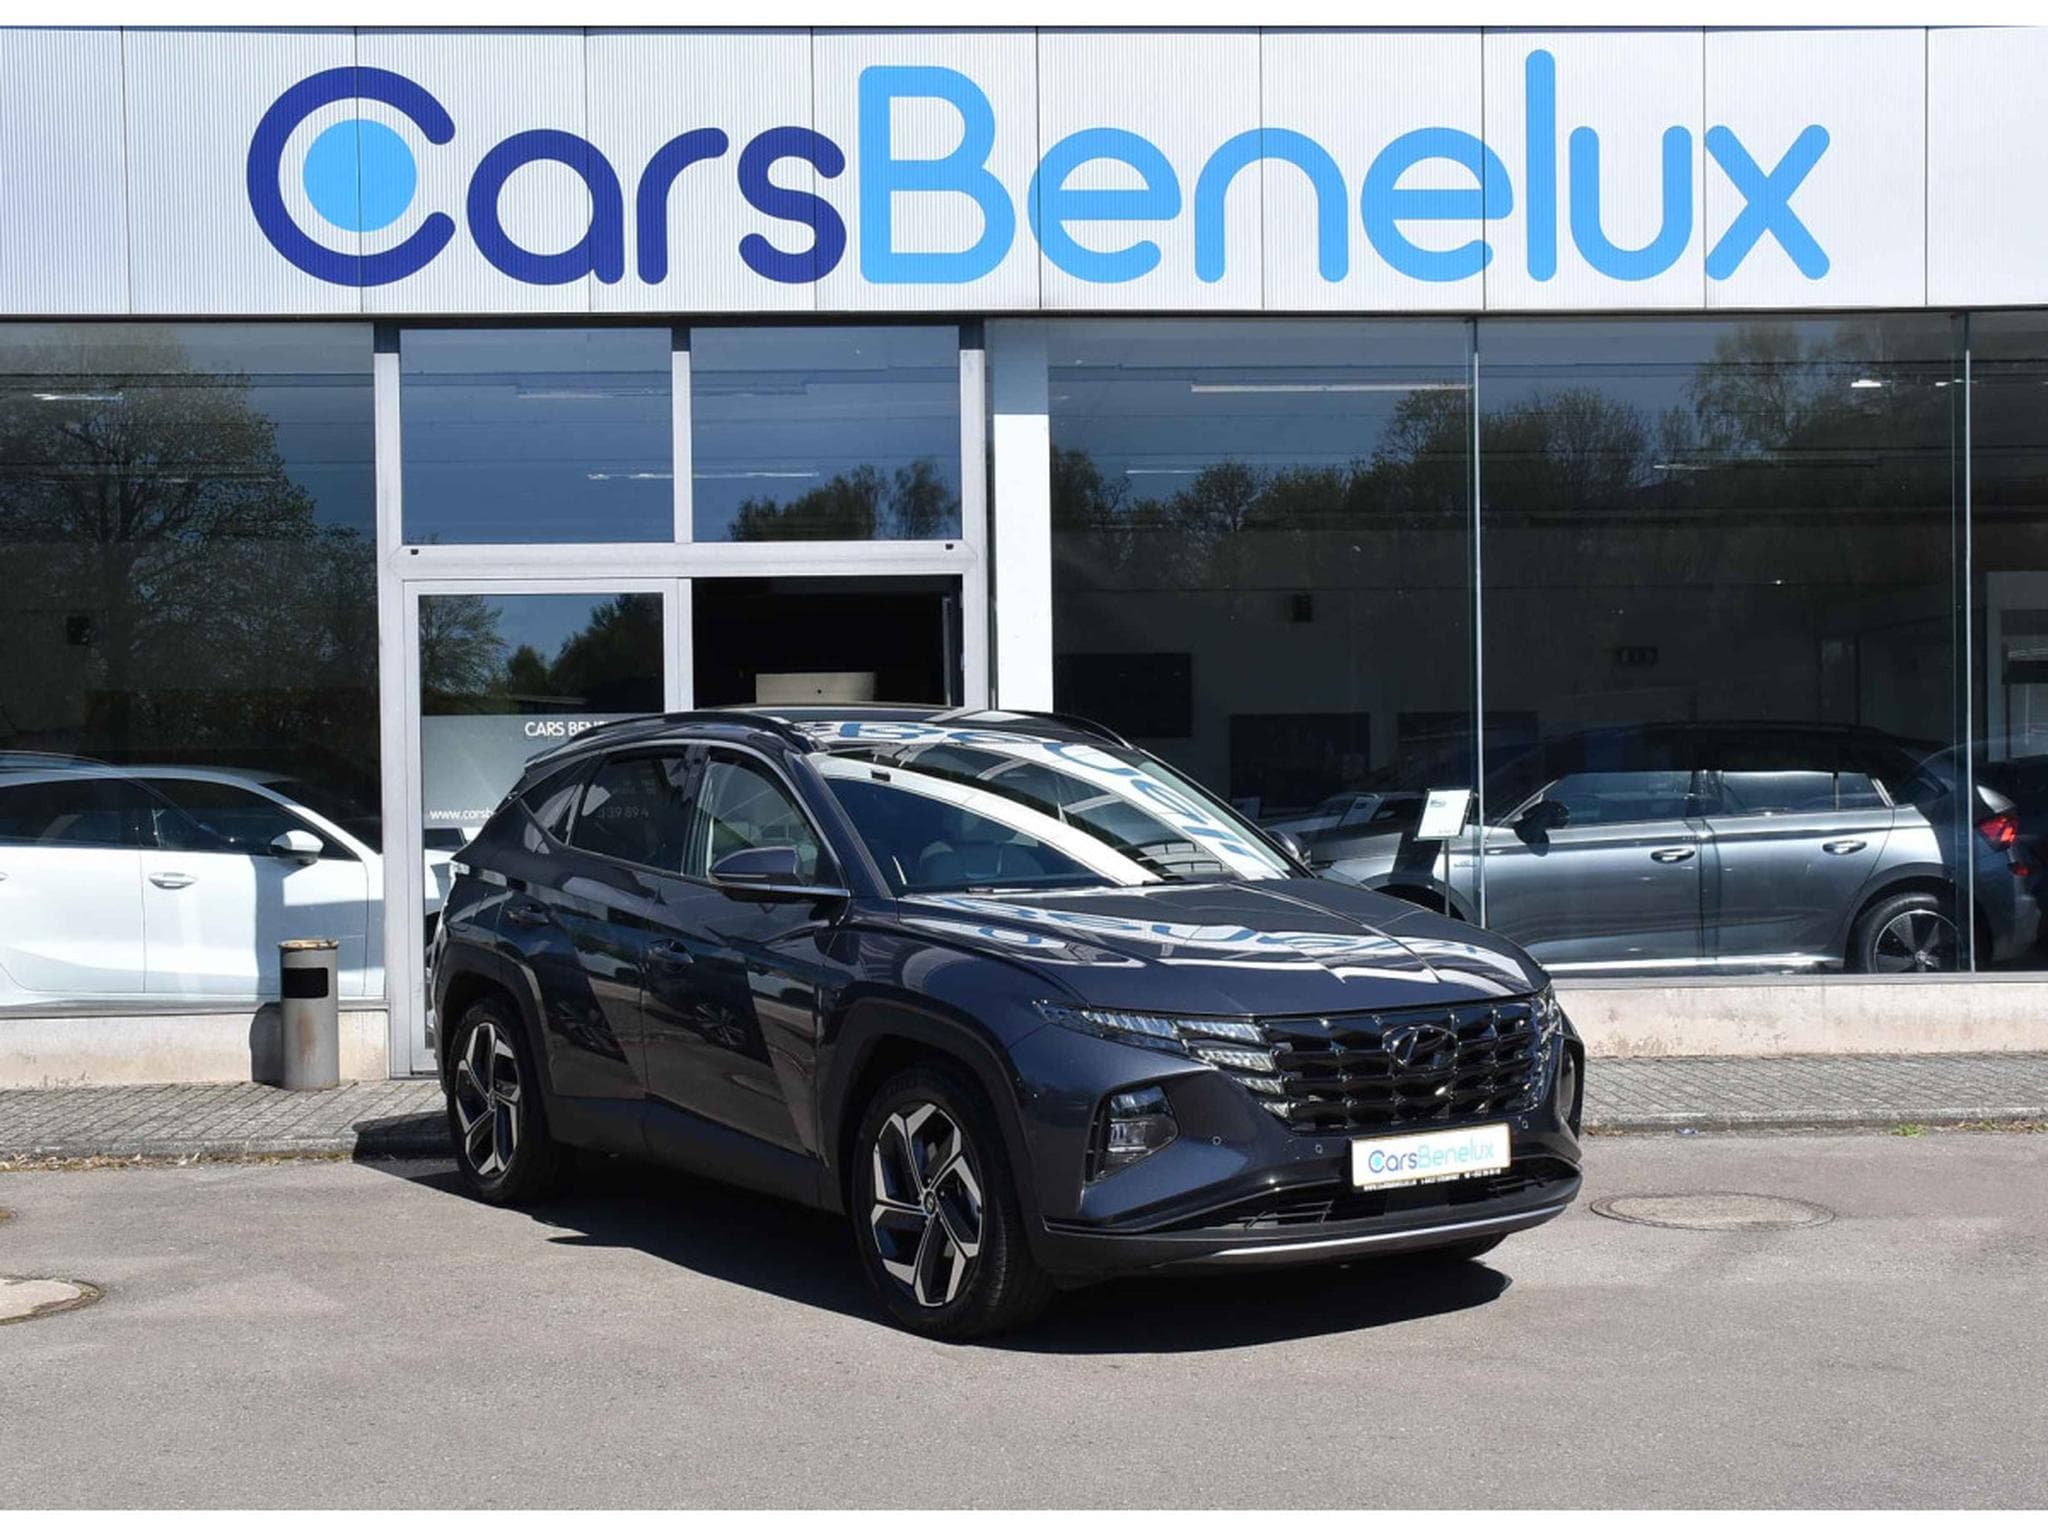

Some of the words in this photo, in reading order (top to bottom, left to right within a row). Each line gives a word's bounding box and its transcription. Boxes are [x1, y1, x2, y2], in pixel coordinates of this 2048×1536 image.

[246, 48, 1831, 286] CarsBenelux
[524, 721, 565, 737] CARS
[1367, 1136, 1495, 1174] CarsBenelux
